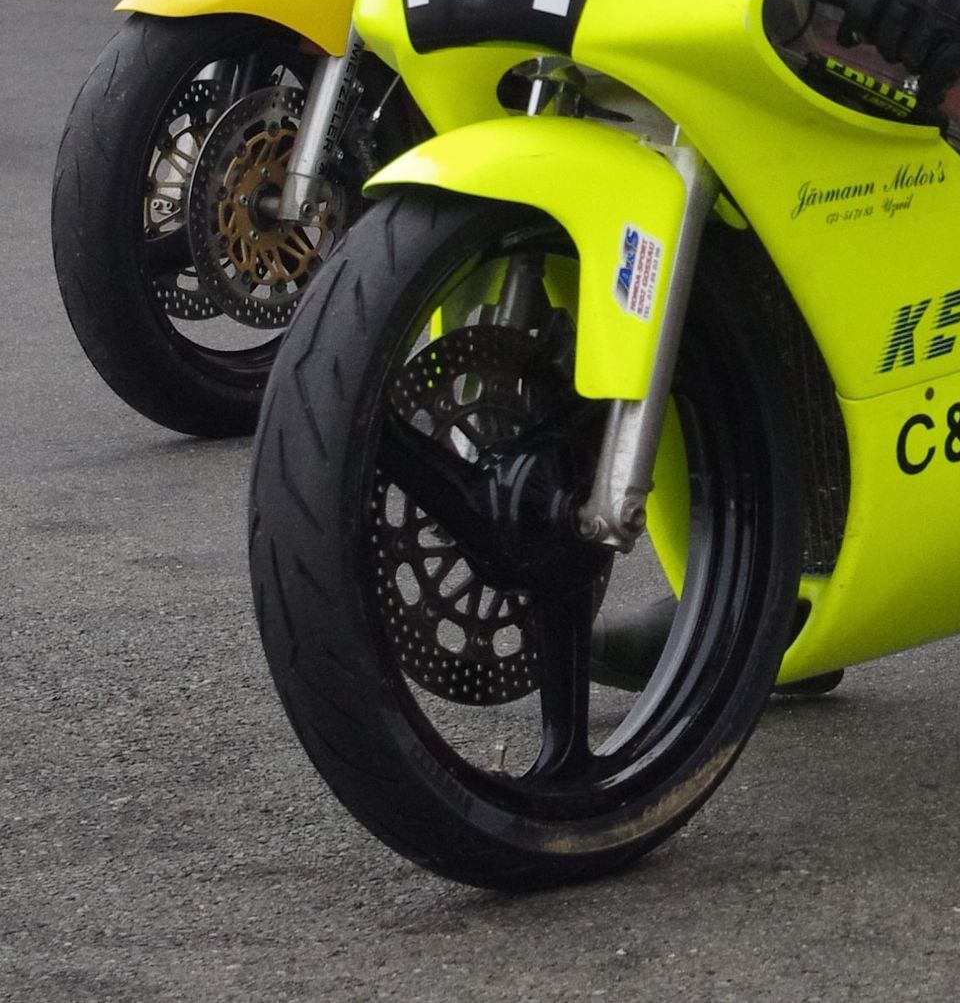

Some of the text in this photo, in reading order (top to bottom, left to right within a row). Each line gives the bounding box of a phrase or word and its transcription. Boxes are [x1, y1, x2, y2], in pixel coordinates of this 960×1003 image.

[323, 43, 362, 153] METZELER
[791, 160, 946, 220] Järmann Motor's
